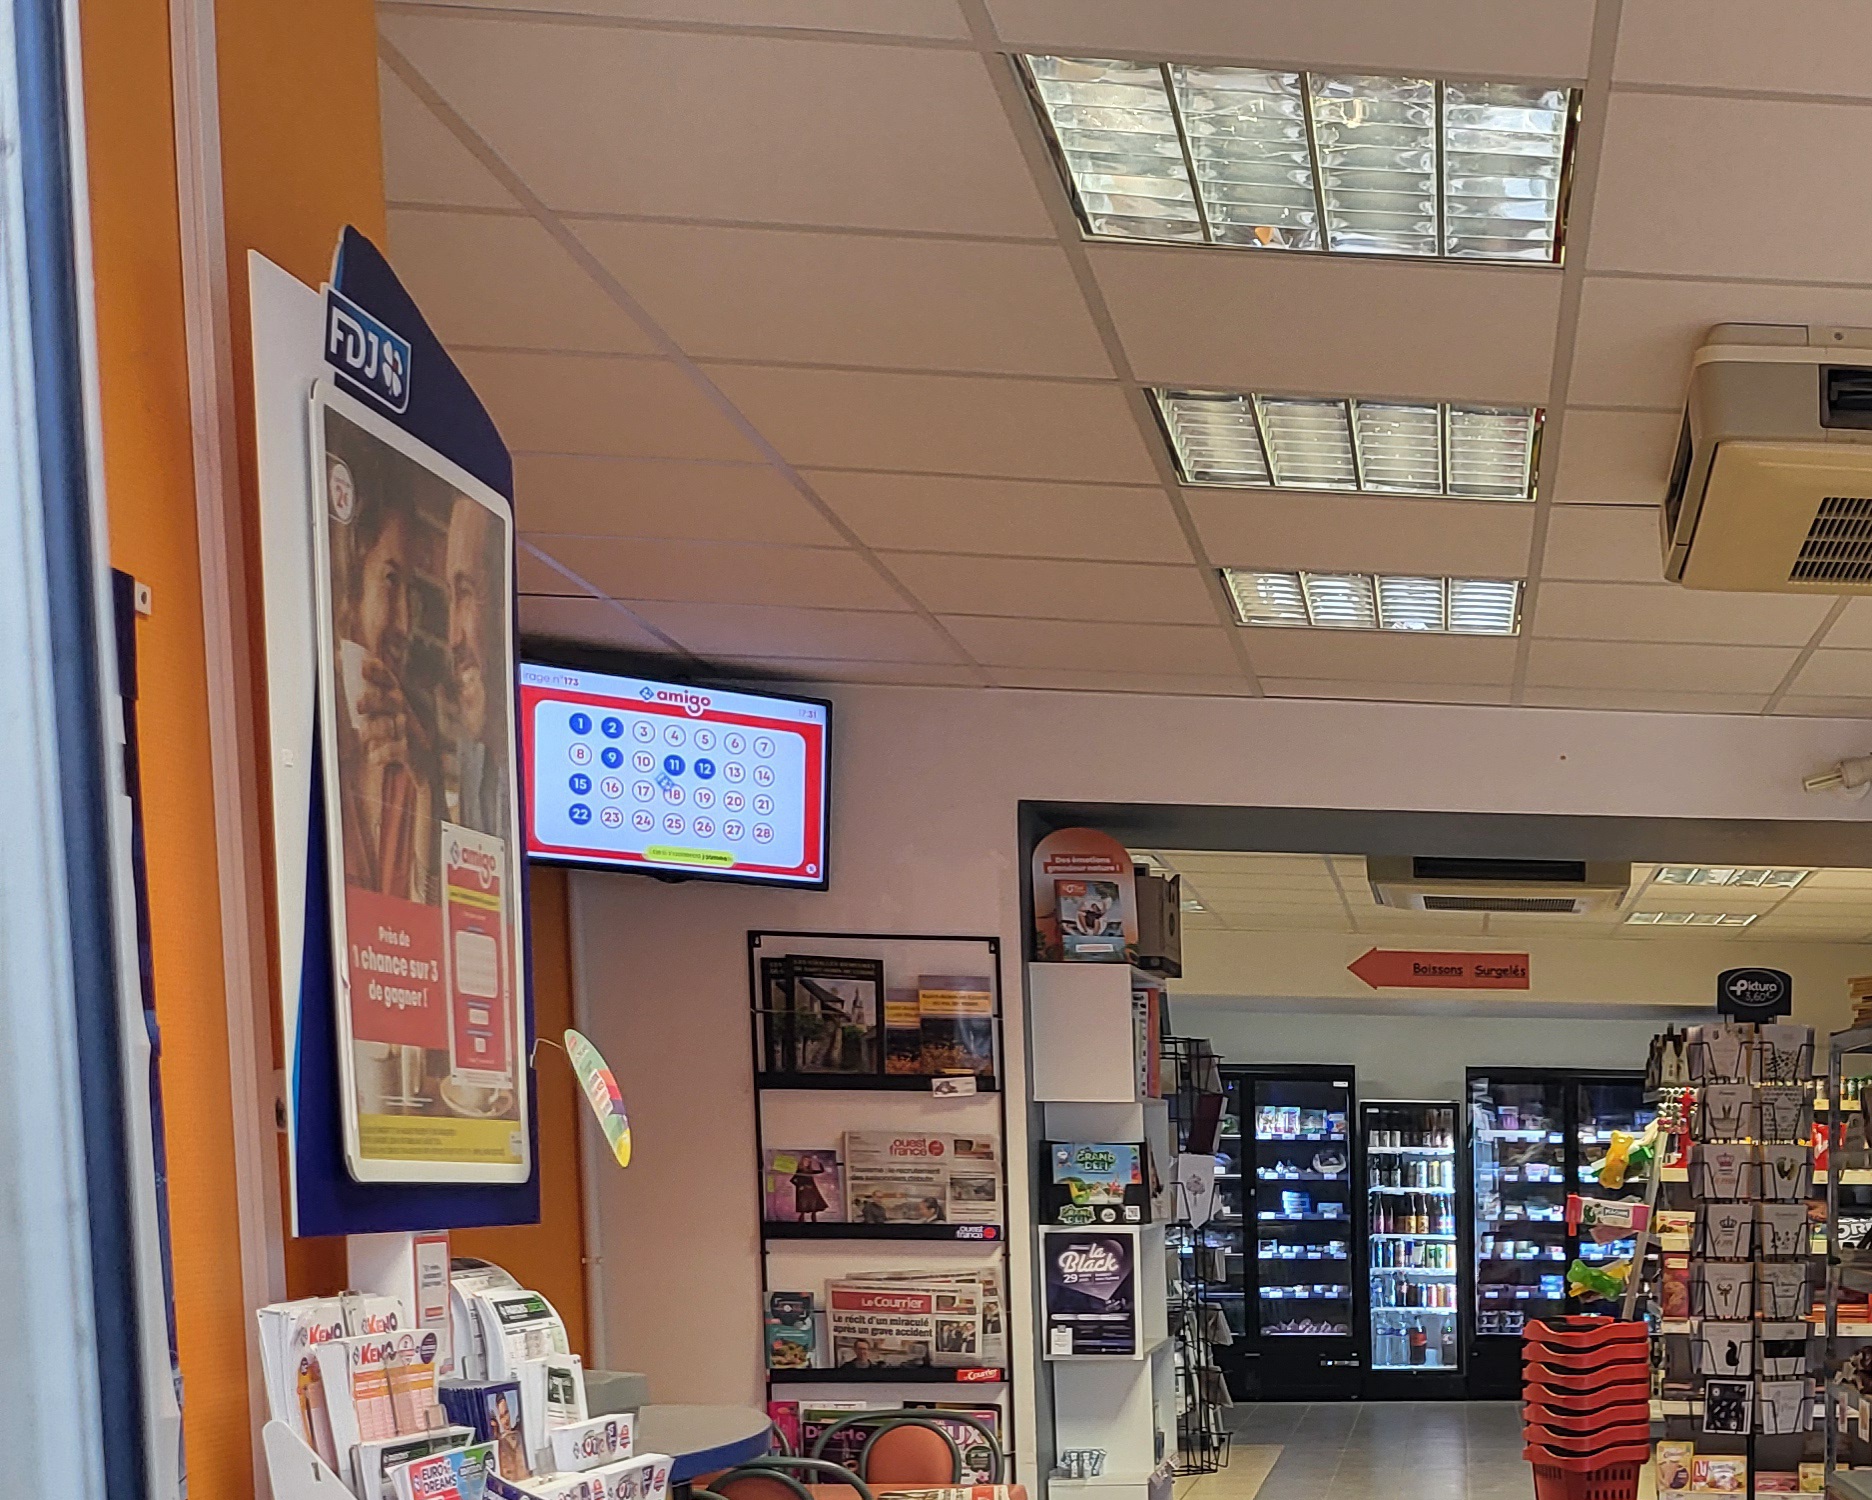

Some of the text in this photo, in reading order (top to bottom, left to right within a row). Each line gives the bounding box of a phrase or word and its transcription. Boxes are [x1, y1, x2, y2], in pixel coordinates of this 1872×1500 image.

[330, 305, 379, 379] FDJ
[657, 690, 711, 713] amigo
[576, 718, 768, 752] 1 2 3 4 5 6 7
[576, 749, 770, 781] 8 9 10 11 12 13 14
[574, 778, 770, 810] 15 16 17 18 19 20 21
[572, 809, 771, 838] 22 23 24 25 26 27 28
[398, 931, 411, 947] de
[361, 950, 408, 976] chance
[409, 959, 430, 980] sur
[430, 960, 439, 982] 3
[1413, 963, 1526, 979] Boissons Surgelés
[369, 980, 383, 1000] de
[384, 984, 422, 1010] gagner
[1729, 979, 1777, 996] Pictura
[890, 1145, 927, 1157] france
[893, 1138, 927, 1149] ouest
[1077, 1151, 1116, 1162] GRAND
[956, 1230, 984, 1239] france
[1089, 1243, 1106, 1258] la
[1058, 1251, 1119, 1272] Black
[1063, 1274, 1078, 1284] 29
[873, 1296, 923, 1309] Courrier
[368, 1312, 398, 1334] KENO
[833, 1314, 929, 1328] Le récit d'un miraculé
[310, 1322, 343, 1344] KENO
[833, 1326, 933, 1338] après un grave accident
[361, 1341, 397, 1365] KENO
[805, 1425, 867, 1441] Dierto
[422, 1463, 443, 1480] EURO
[423, 1474, 457, 1493] DREAMS
